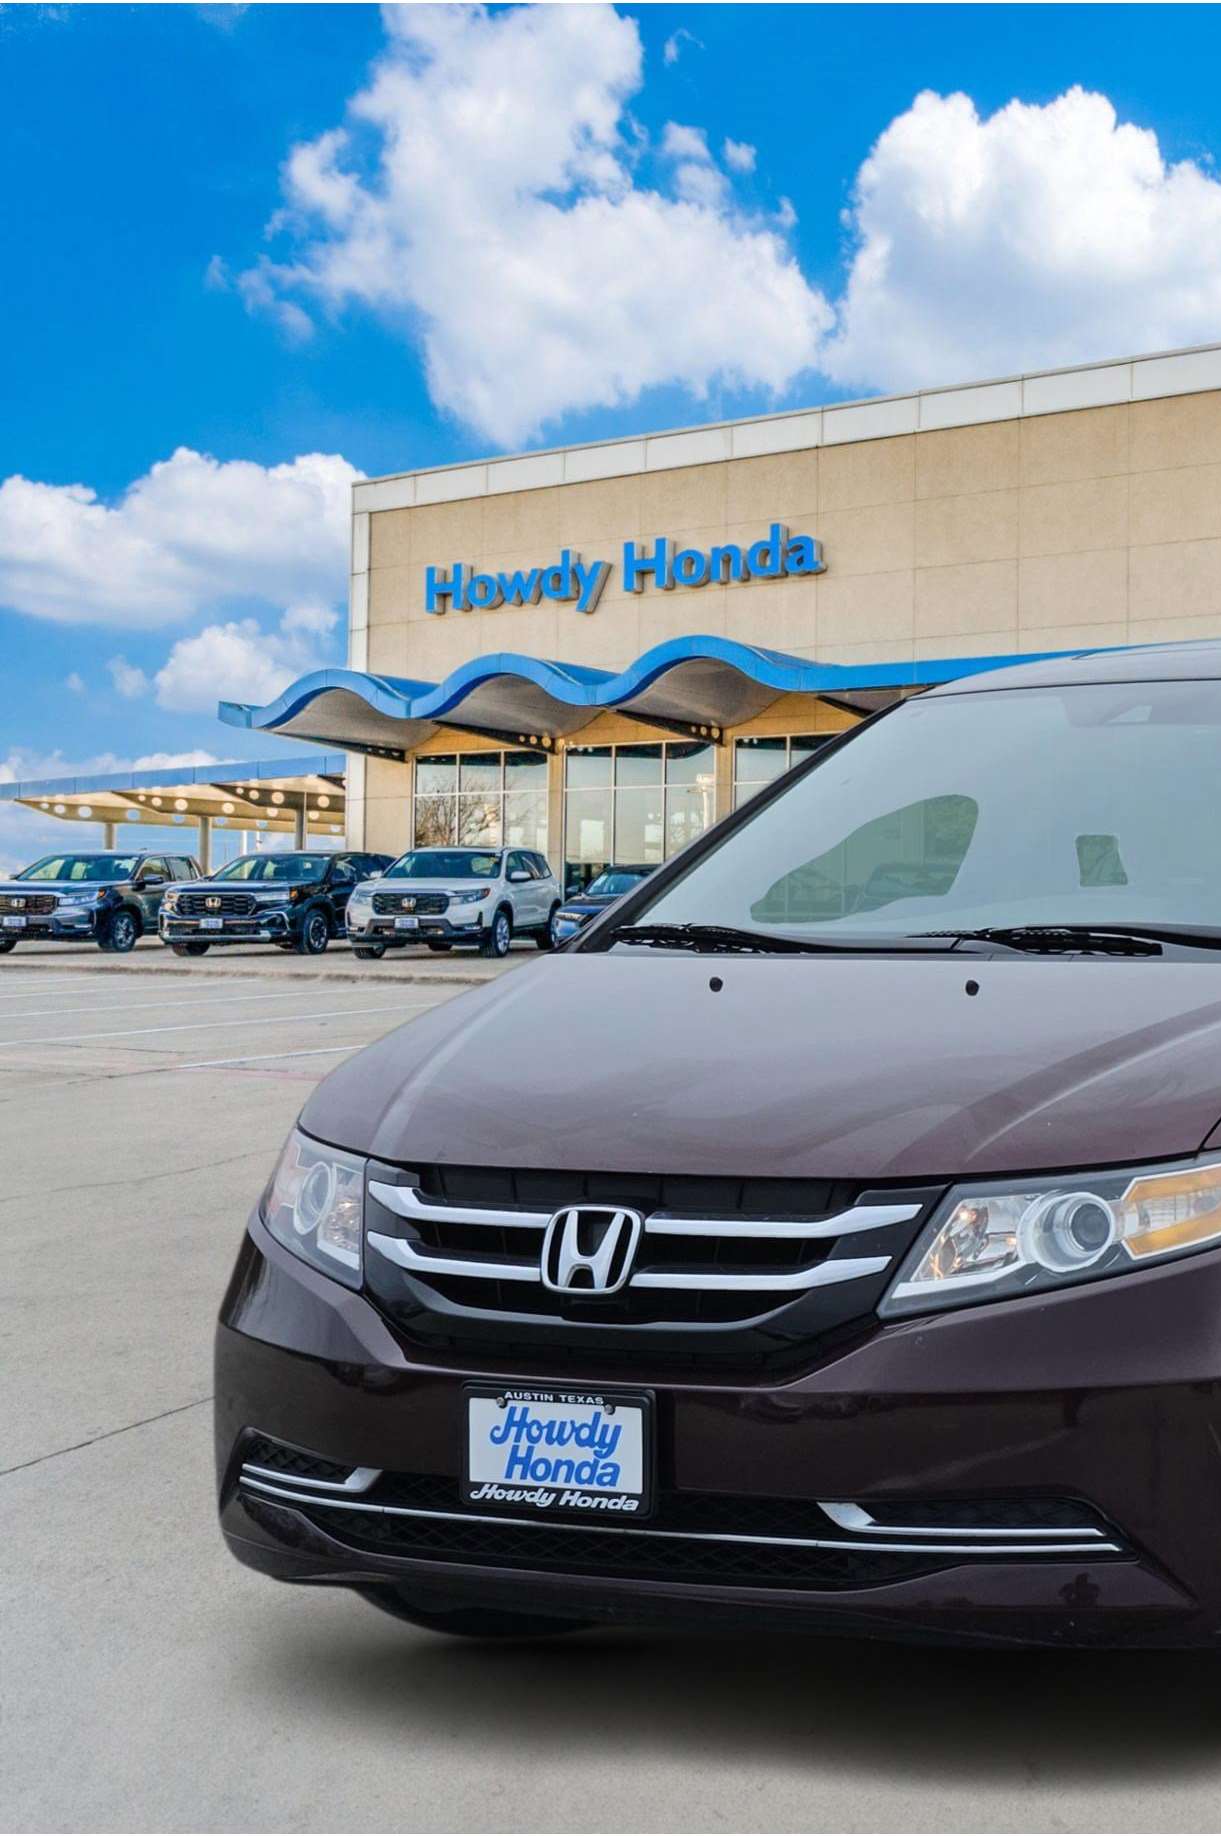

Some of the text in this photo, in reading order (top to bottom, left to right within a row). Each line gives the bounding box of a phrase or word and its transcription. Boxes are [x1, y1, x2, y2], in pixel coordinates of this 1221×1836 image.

[424, 523, 827, 615] Howdy Honda
[504, 1391, 604, 1405] AUSTIN TEXAS
[489, 1405, 623, 1459] Howdy
[504, 1445, 621, 1487] Honda
[470, 1484, 639, 1512] Howdy Honda
